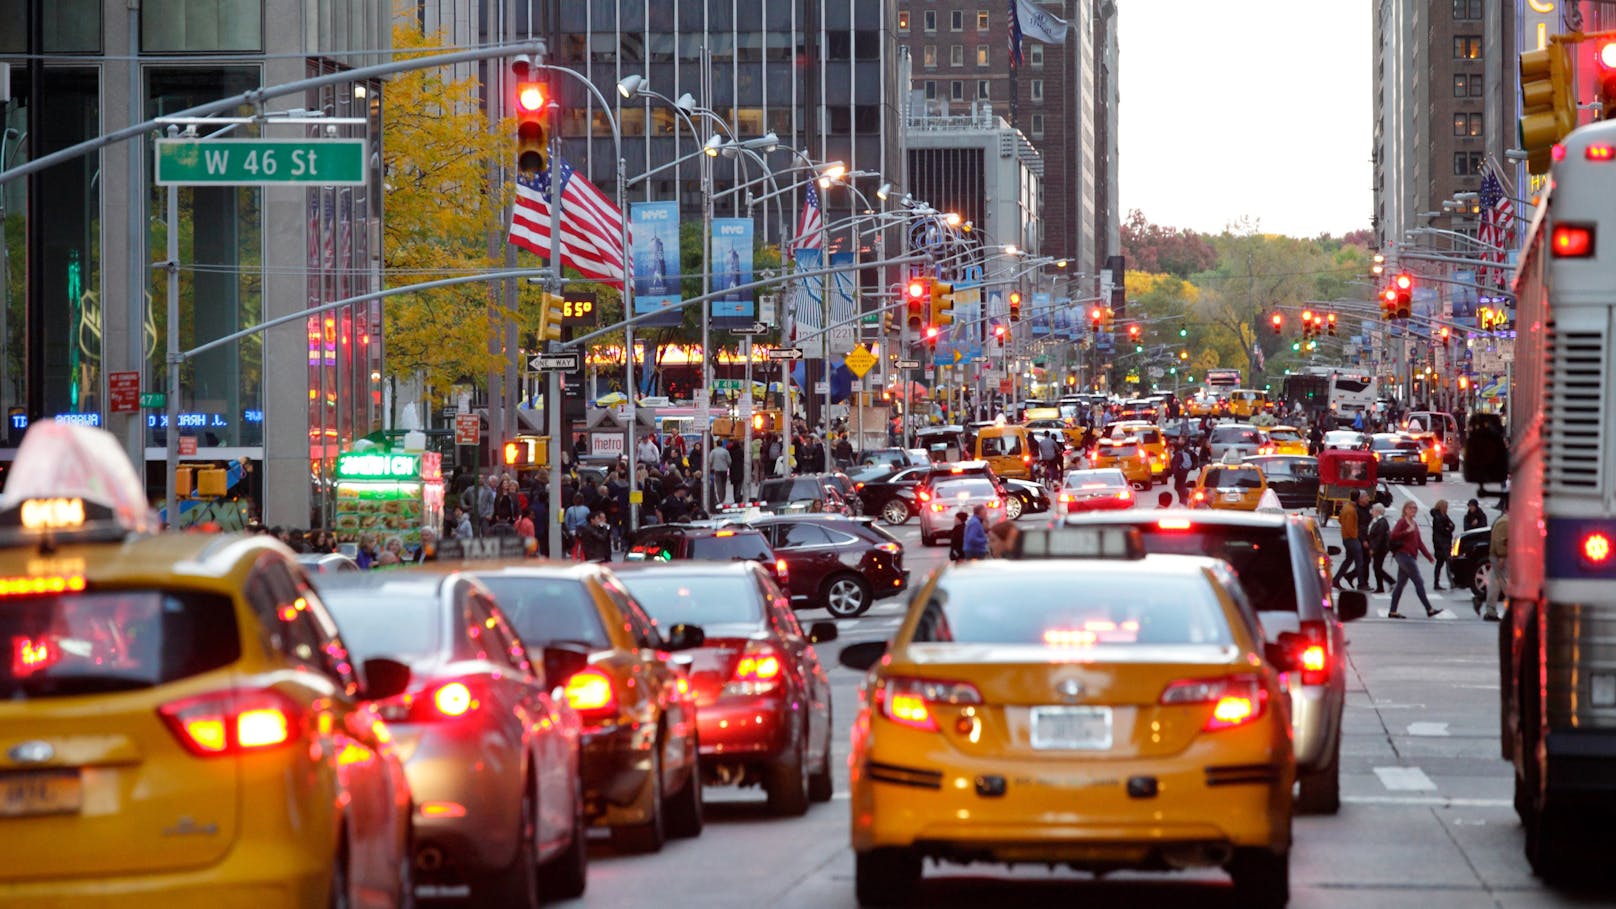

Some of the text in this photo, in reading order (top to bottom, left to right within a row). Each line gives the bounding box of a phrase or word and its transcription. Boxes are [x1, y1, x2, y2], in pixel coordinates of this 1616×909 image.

[205, 149, 318, 175] W 46 St
[641, 209, 668, 220] NYC
[721, 225, 744, 234] NYC
[832, 328, 851, 339] 1221
[535, 359, 571, 368] ONE WAY
[139, 394, 153, 406] 47
[594, 437, 622, 450] metro
[462, 537, 501, 559] TAXI
